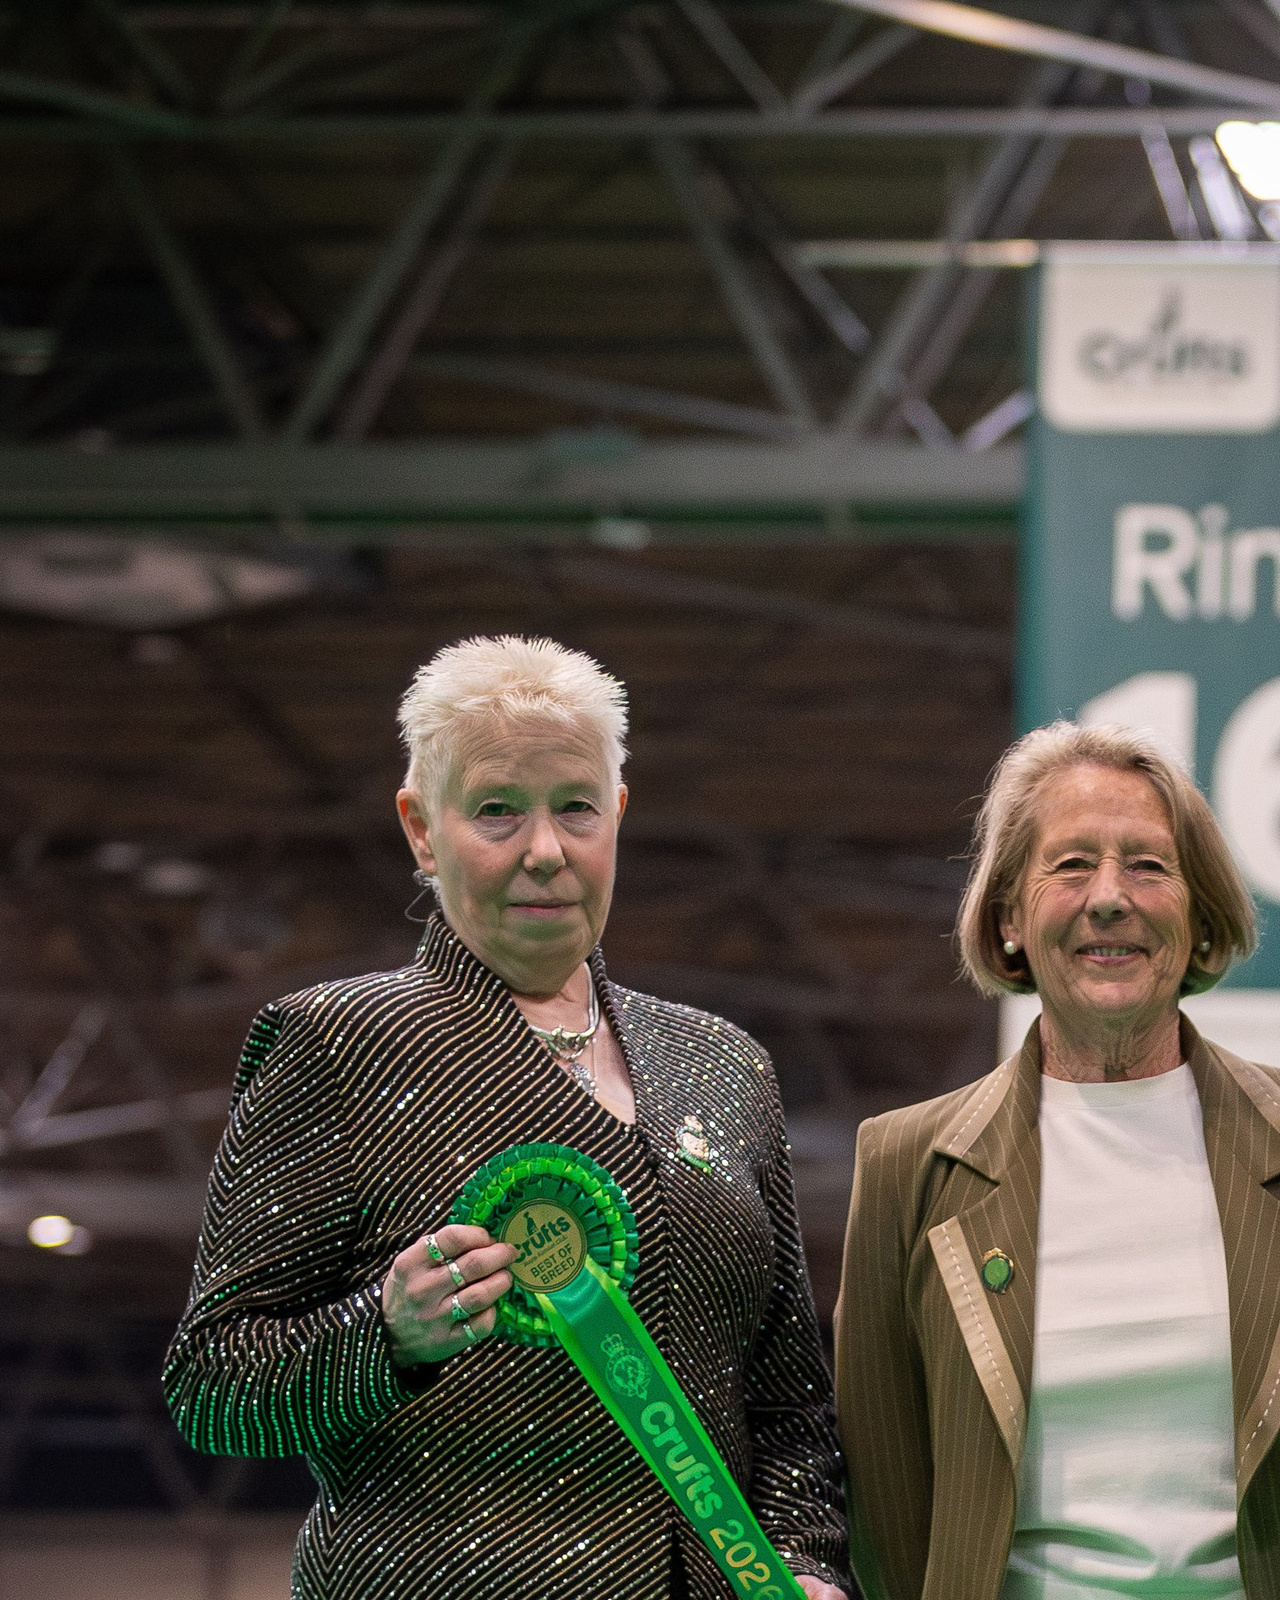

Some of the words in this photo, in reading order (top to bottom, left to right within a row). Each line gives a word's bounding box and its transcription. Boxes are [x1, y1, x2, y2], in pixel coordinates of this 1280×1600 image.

[530, 1254, 557, 1277] BEST
[558, 1243, 573, 1259] OF
[540, 1257, 575, 1285] BREED
[640, 1401, 722, 1519] Crufts
